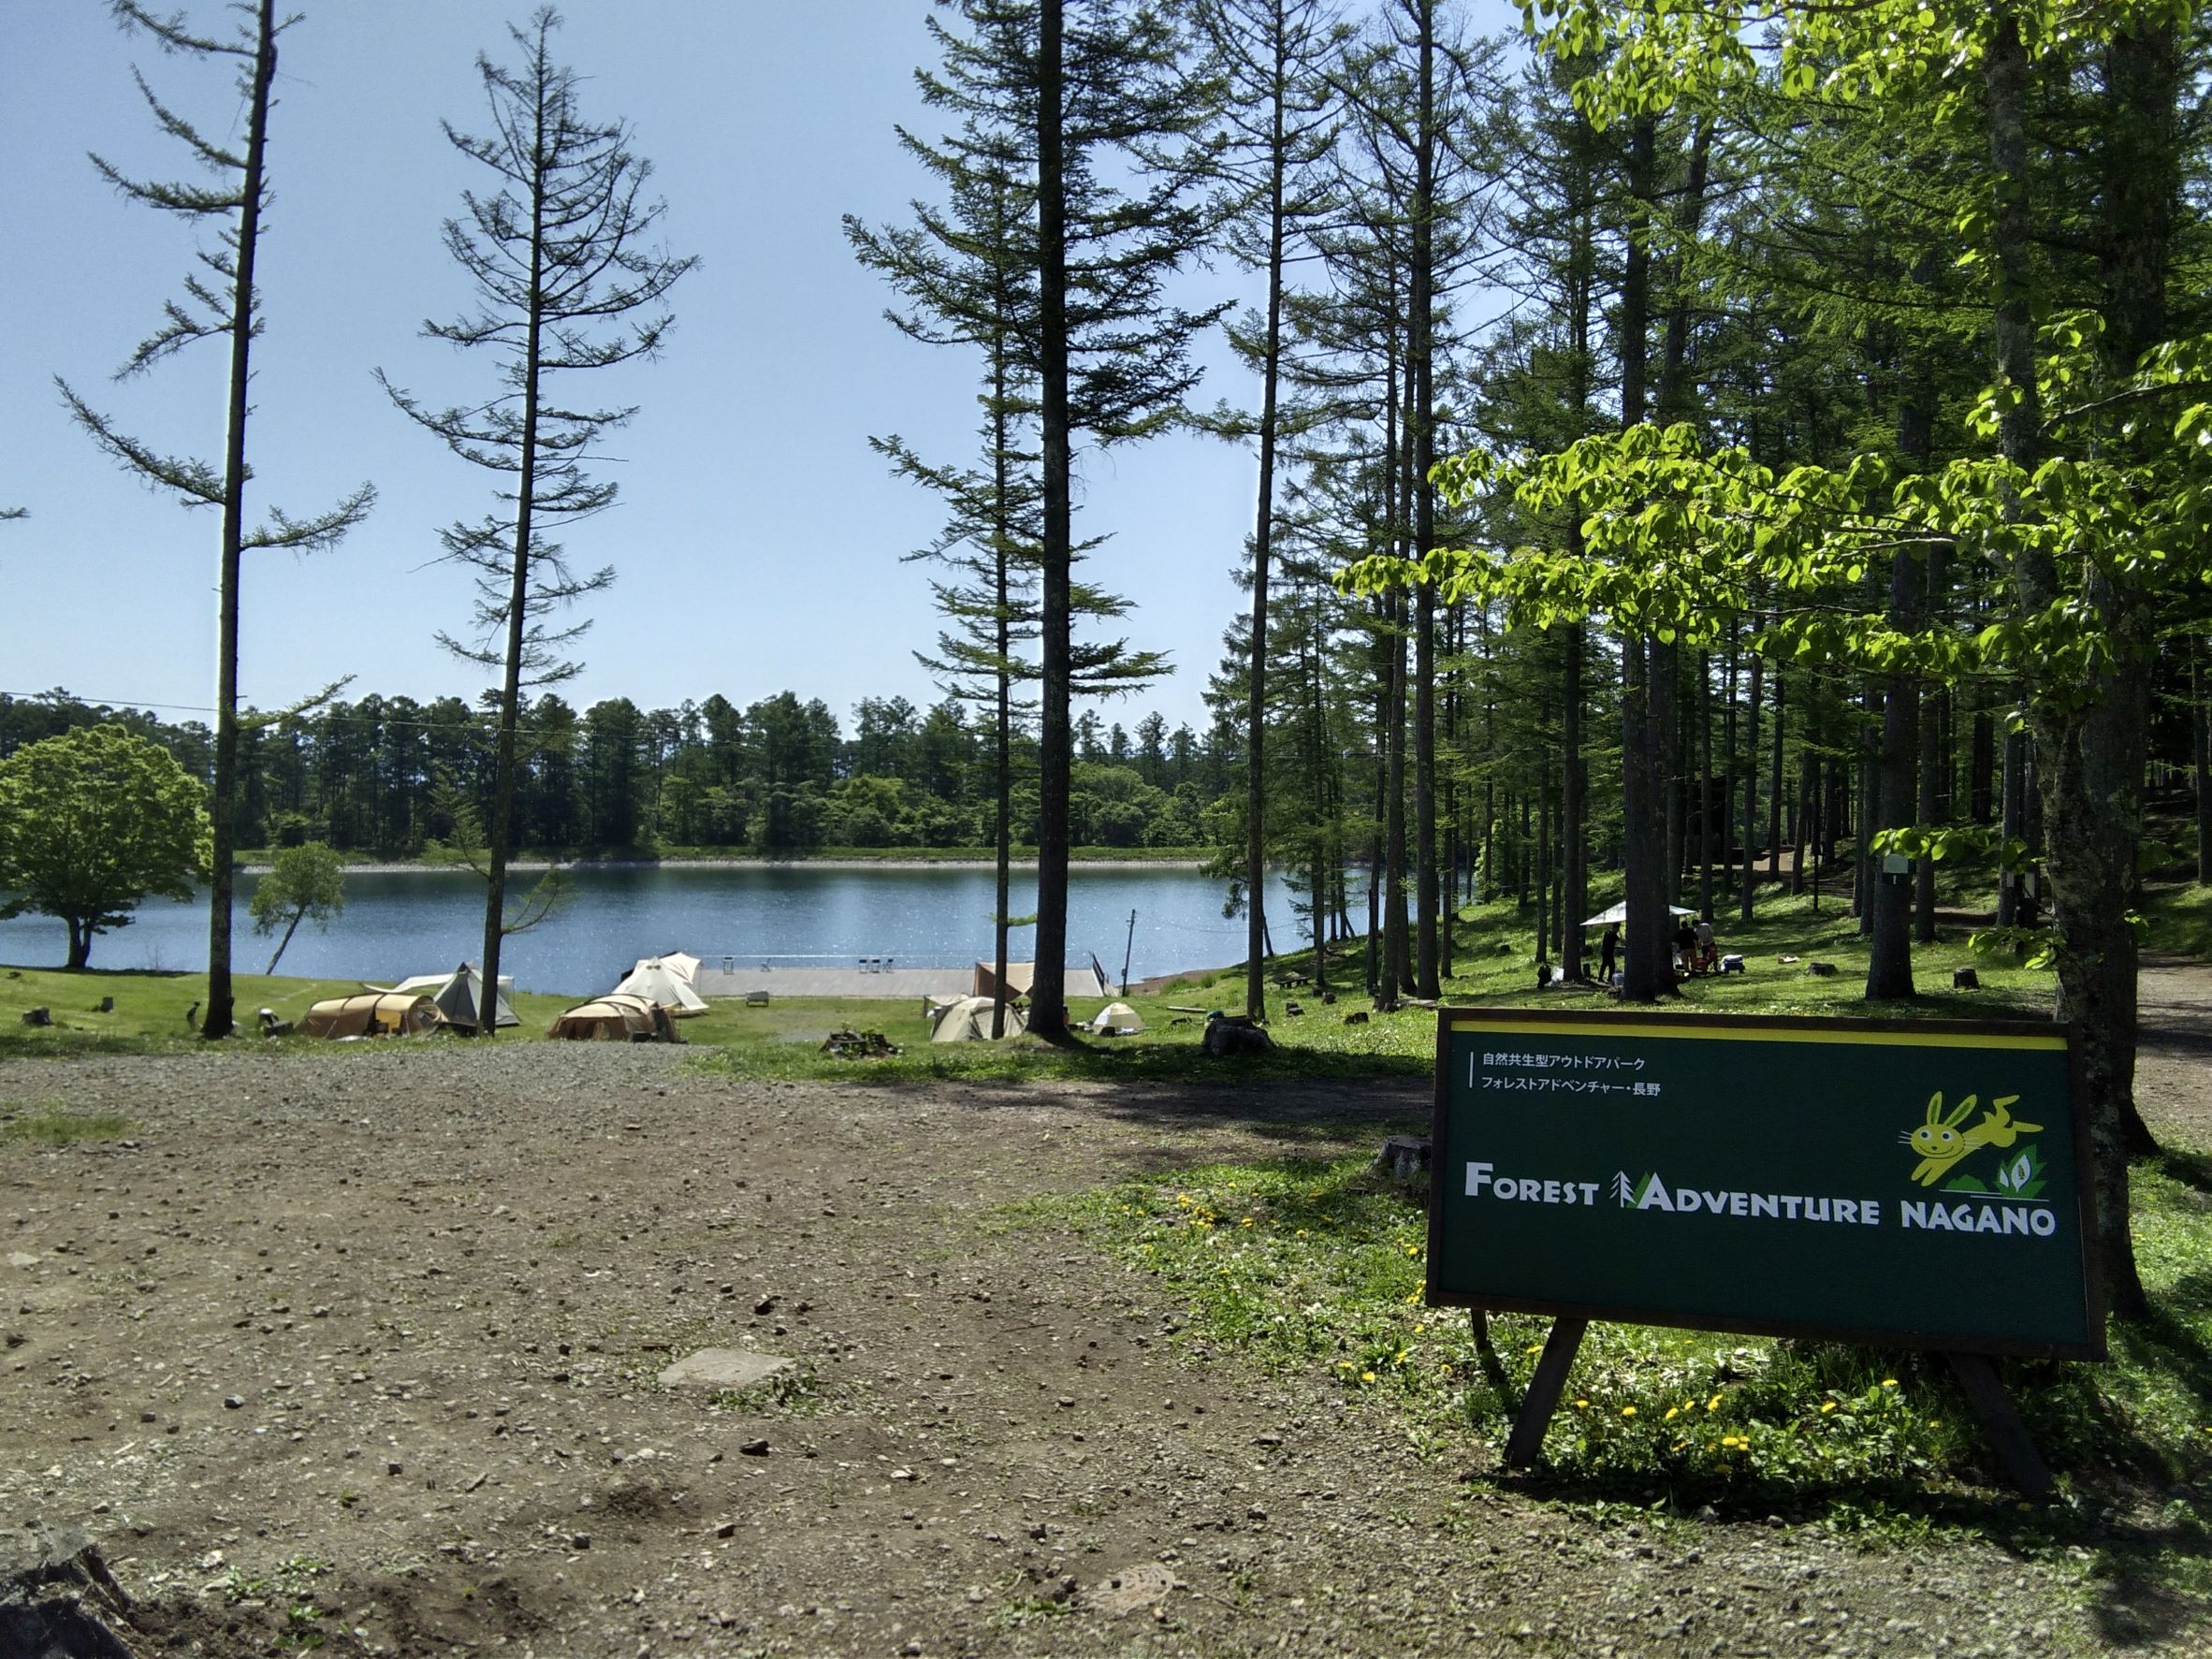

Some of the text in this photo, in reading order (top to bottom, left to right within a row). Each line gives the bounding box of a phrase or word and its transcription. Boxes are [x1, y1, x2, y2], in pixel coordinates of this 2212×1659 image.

[1482, 1052, 1645, 1070] 自然共生型アウトドアパーク
[1481, 1077, 1661, 1097] フォレストアドベンチャー・長野
[1464, 1161, 2056, 1236] FOREST ADVENTURE NAGANO
